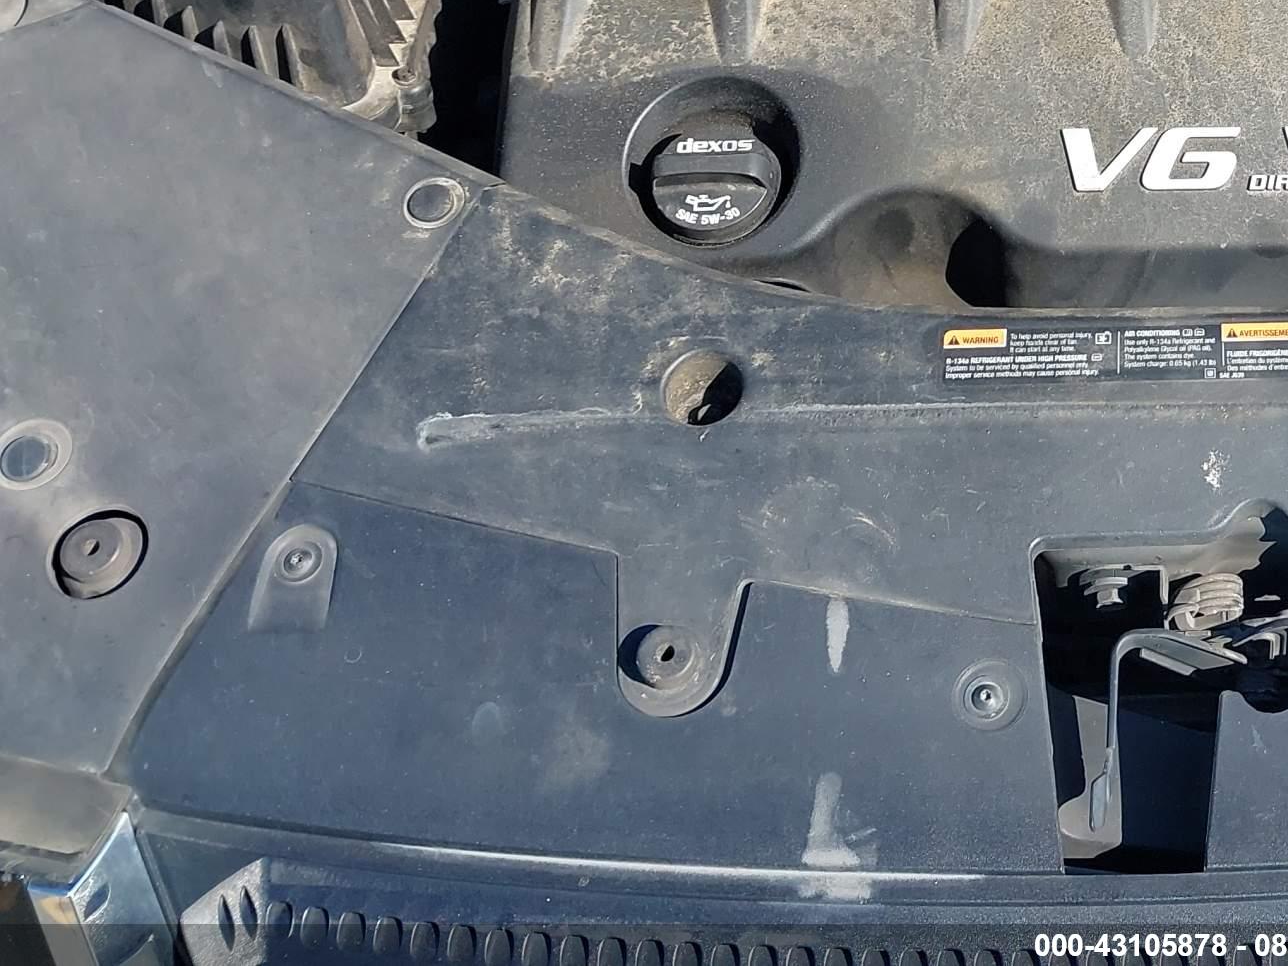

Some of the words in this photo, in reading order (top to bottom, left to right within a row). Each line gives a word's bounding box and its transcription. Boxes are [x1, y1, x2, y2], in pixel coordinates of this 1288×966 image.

[676, 137, 756, 154] dexos
[1060, 126, 1242, 193] V6
[675, 208, 699, 224] SAE
[700, 206, 741, 225] 5W-30
